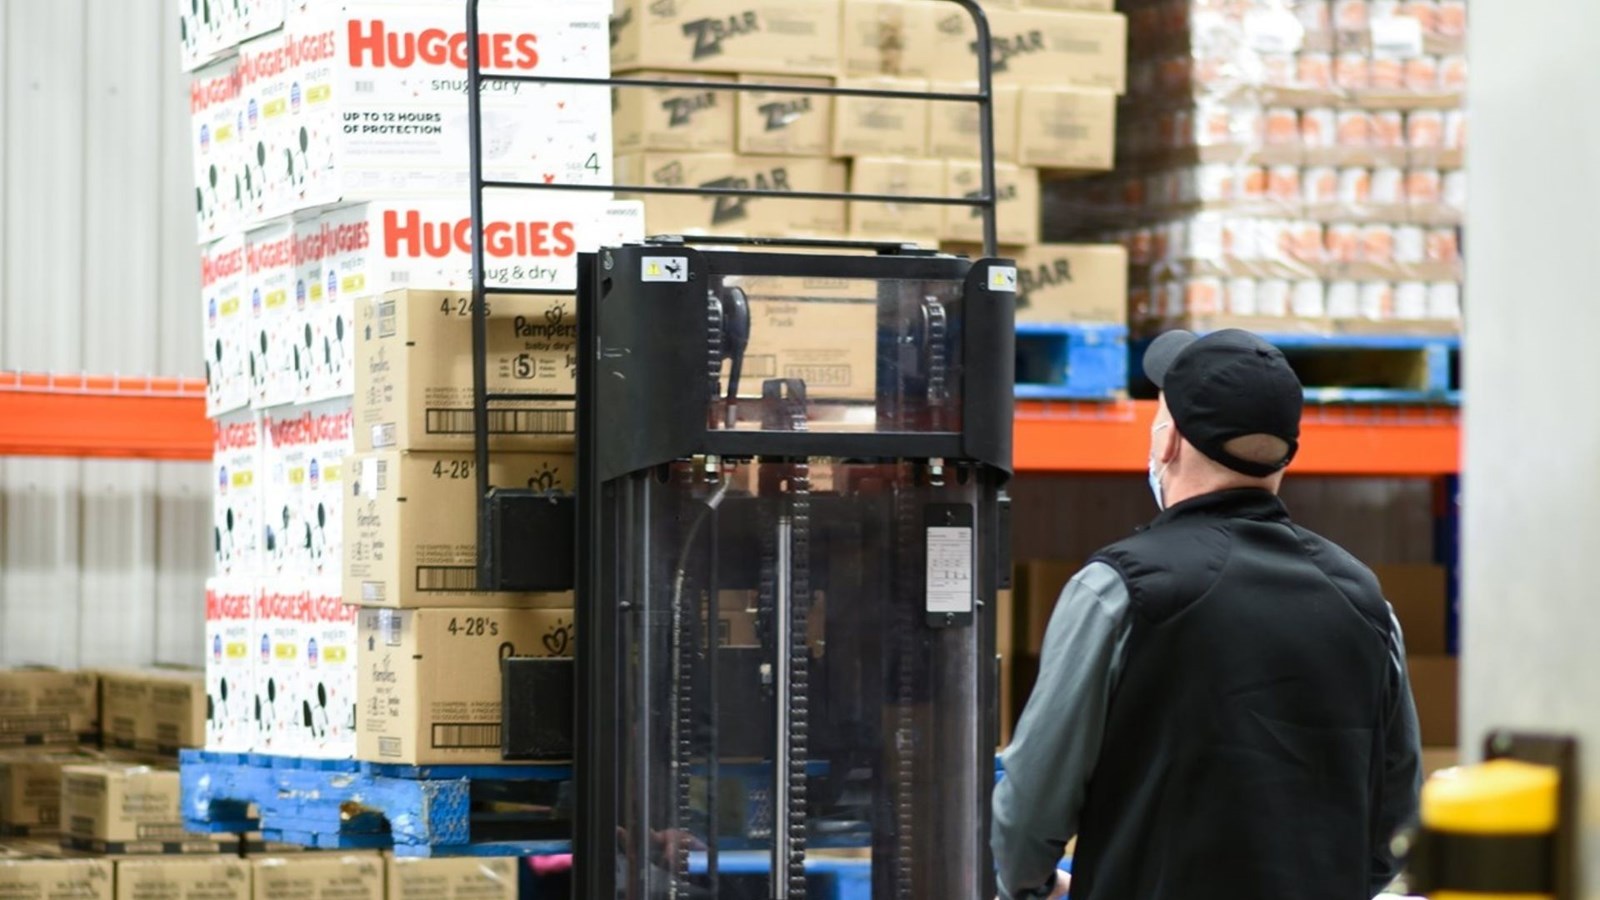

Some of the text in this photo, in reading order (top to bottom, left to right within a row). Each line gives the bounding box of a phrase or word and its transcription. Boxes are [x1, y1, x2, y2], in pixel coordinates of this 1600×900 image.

[347, 19, 539, 69] HUGGIES
[343, 112, 442, 122] UP TO 12 HOURS
[343, 124, 442, 134] OF PROTECTION
[584, 152, 601, 176] 4
[383, 209, 577, 258] HUGGIES
[512, 265, 525, 280] &
[528, 265, 557, 282] dry
[518, 353, 530, 377] 5
[447, 617, 499, 636] 4-28's
